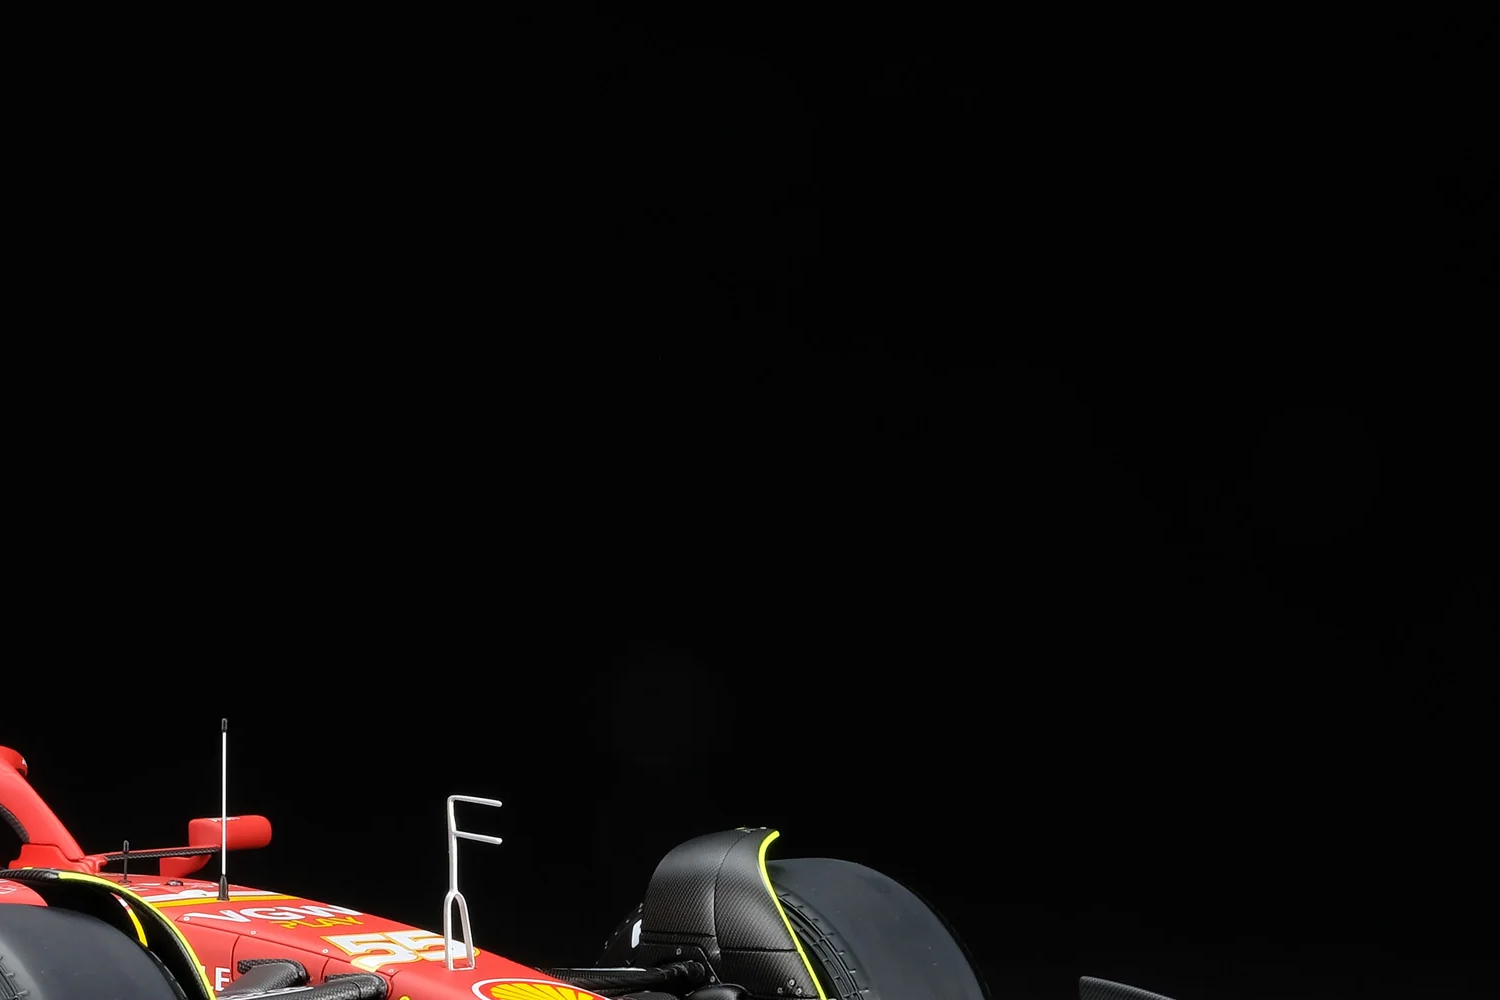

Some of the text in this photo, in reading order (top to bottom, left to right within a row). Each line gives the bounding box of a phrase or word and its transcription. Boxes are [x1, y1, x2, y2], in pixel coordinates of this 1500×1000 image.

[184, 905, 364, 923] VGW
[270, 916, 364, 929] PLAY
[321, 930, 480, 972] 55
